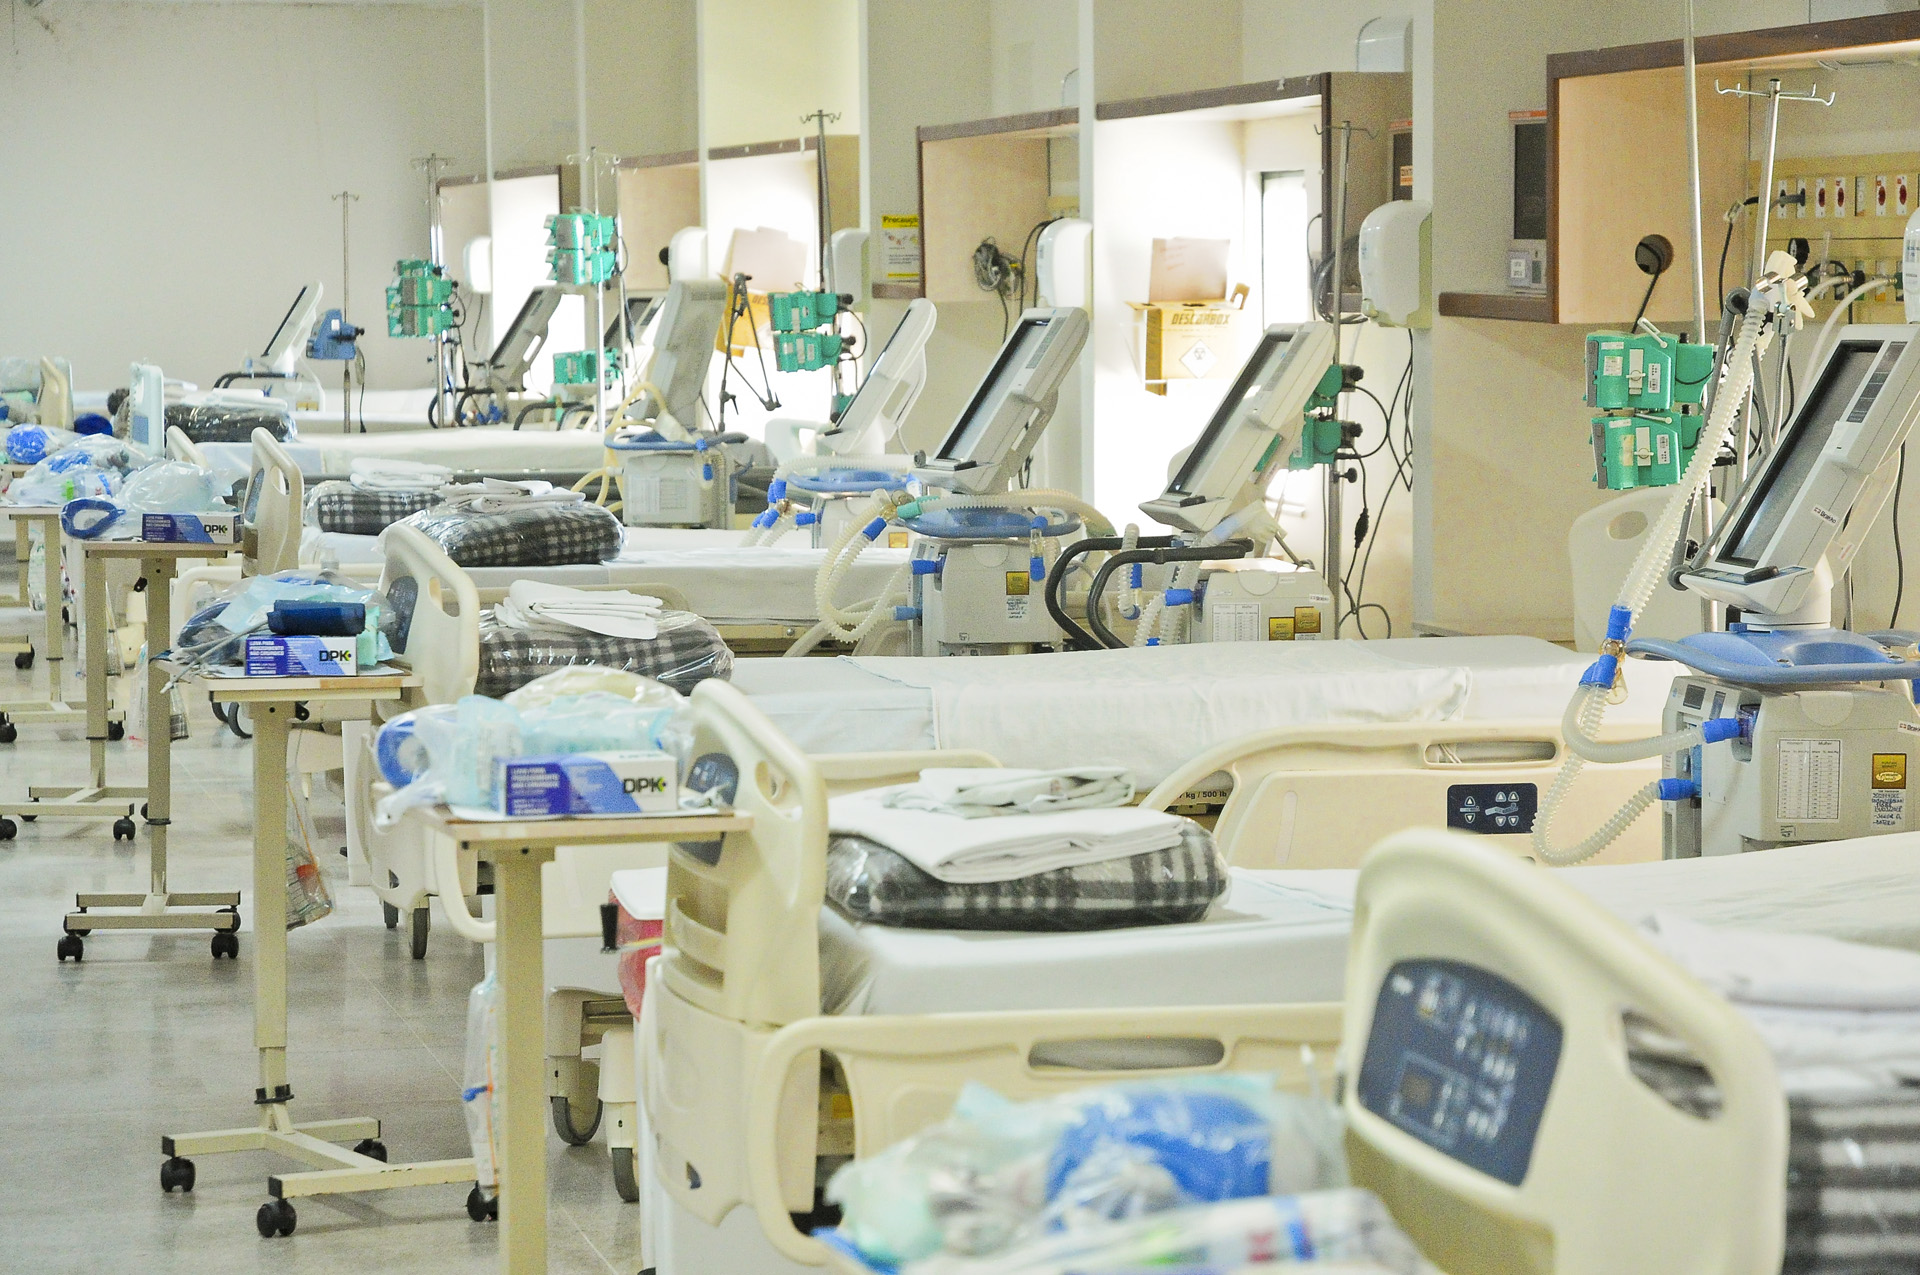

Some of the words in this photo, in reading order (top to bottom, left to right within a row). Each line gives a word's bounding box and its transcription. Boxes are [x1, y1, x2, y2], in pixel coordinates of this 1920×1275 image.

[204, 524, 228, 534] DPK
[319, 650, 351, 661] DPK
[623, 777, 667, 794] DPK
[1186, 791, 1195, 799] kg
[1202, 790, 1217, 798] 500
